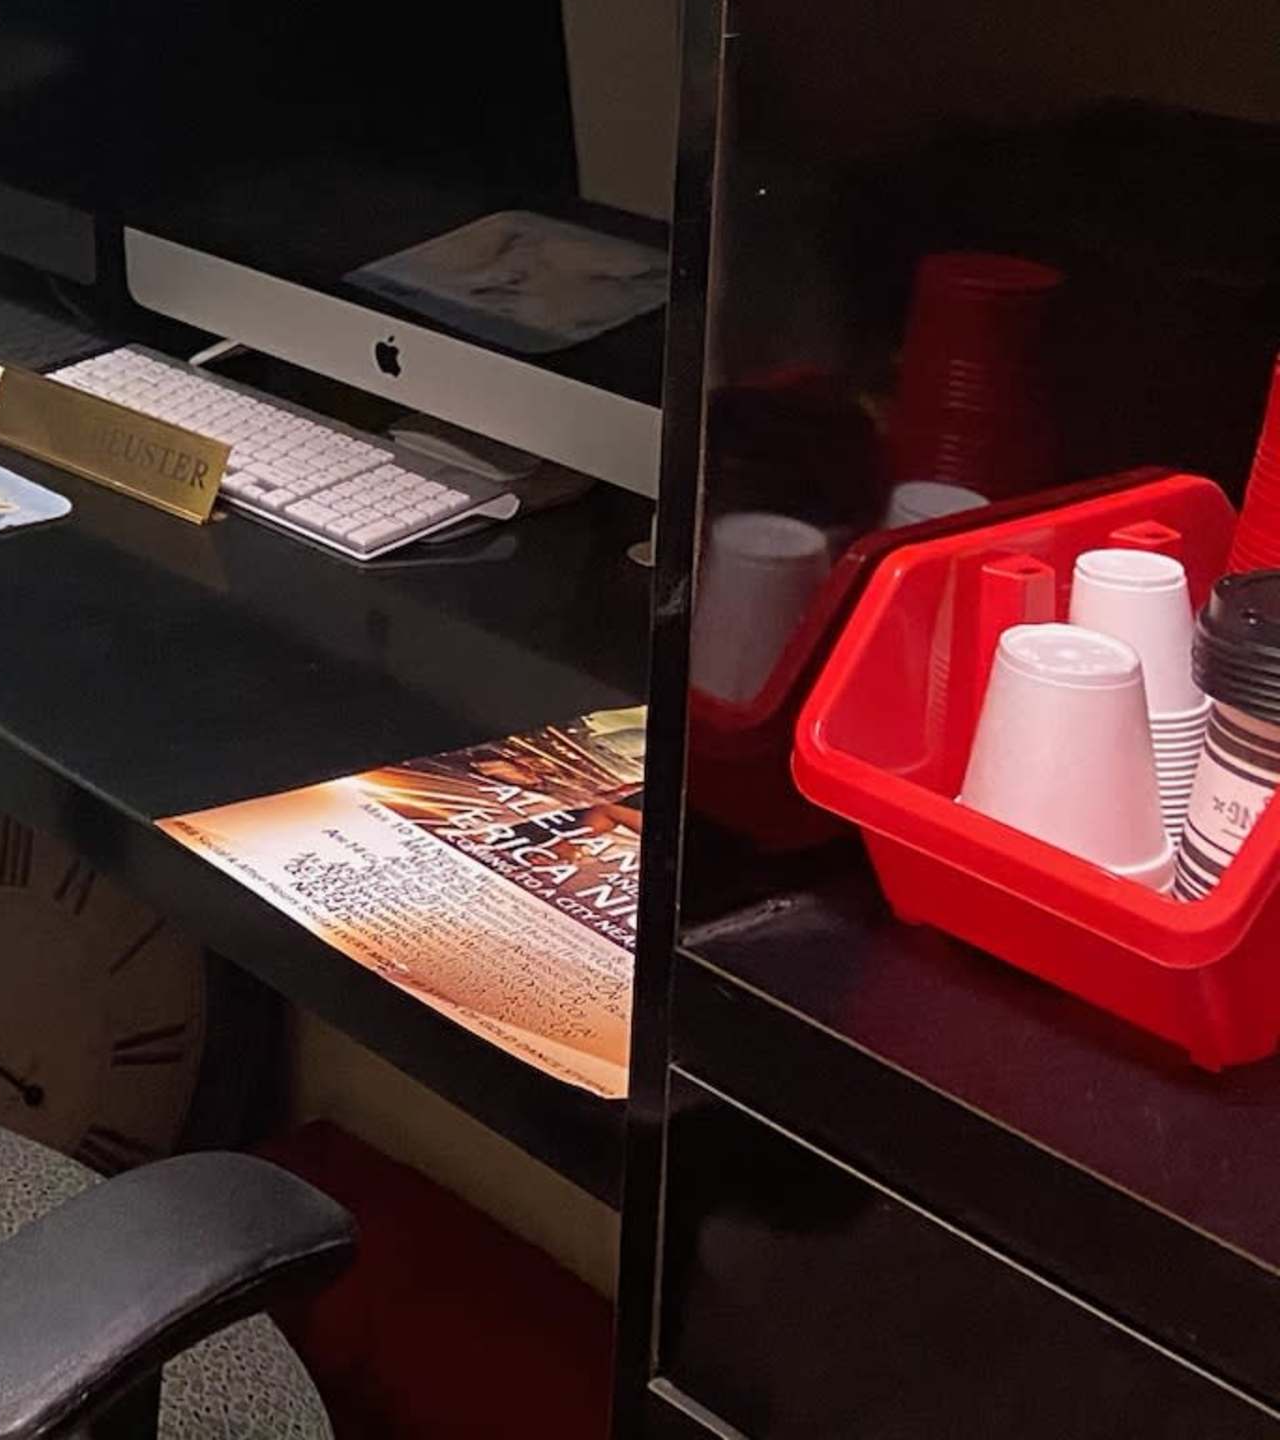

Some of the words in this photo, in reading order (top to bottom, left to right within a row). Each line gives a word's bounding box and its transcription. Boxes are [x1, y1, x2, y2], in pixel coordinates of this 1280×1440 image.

[436, 809, 579, 885] ERICA
[470, 773, 640, 876] ALEJAN
[445, 832, 519, 874] COMING
[514, 872, 543, 889] TO
[540, 888, 558, 898] A
[556, 897, 601, 921] CITY
[595, 919, 637, 948] NEA
